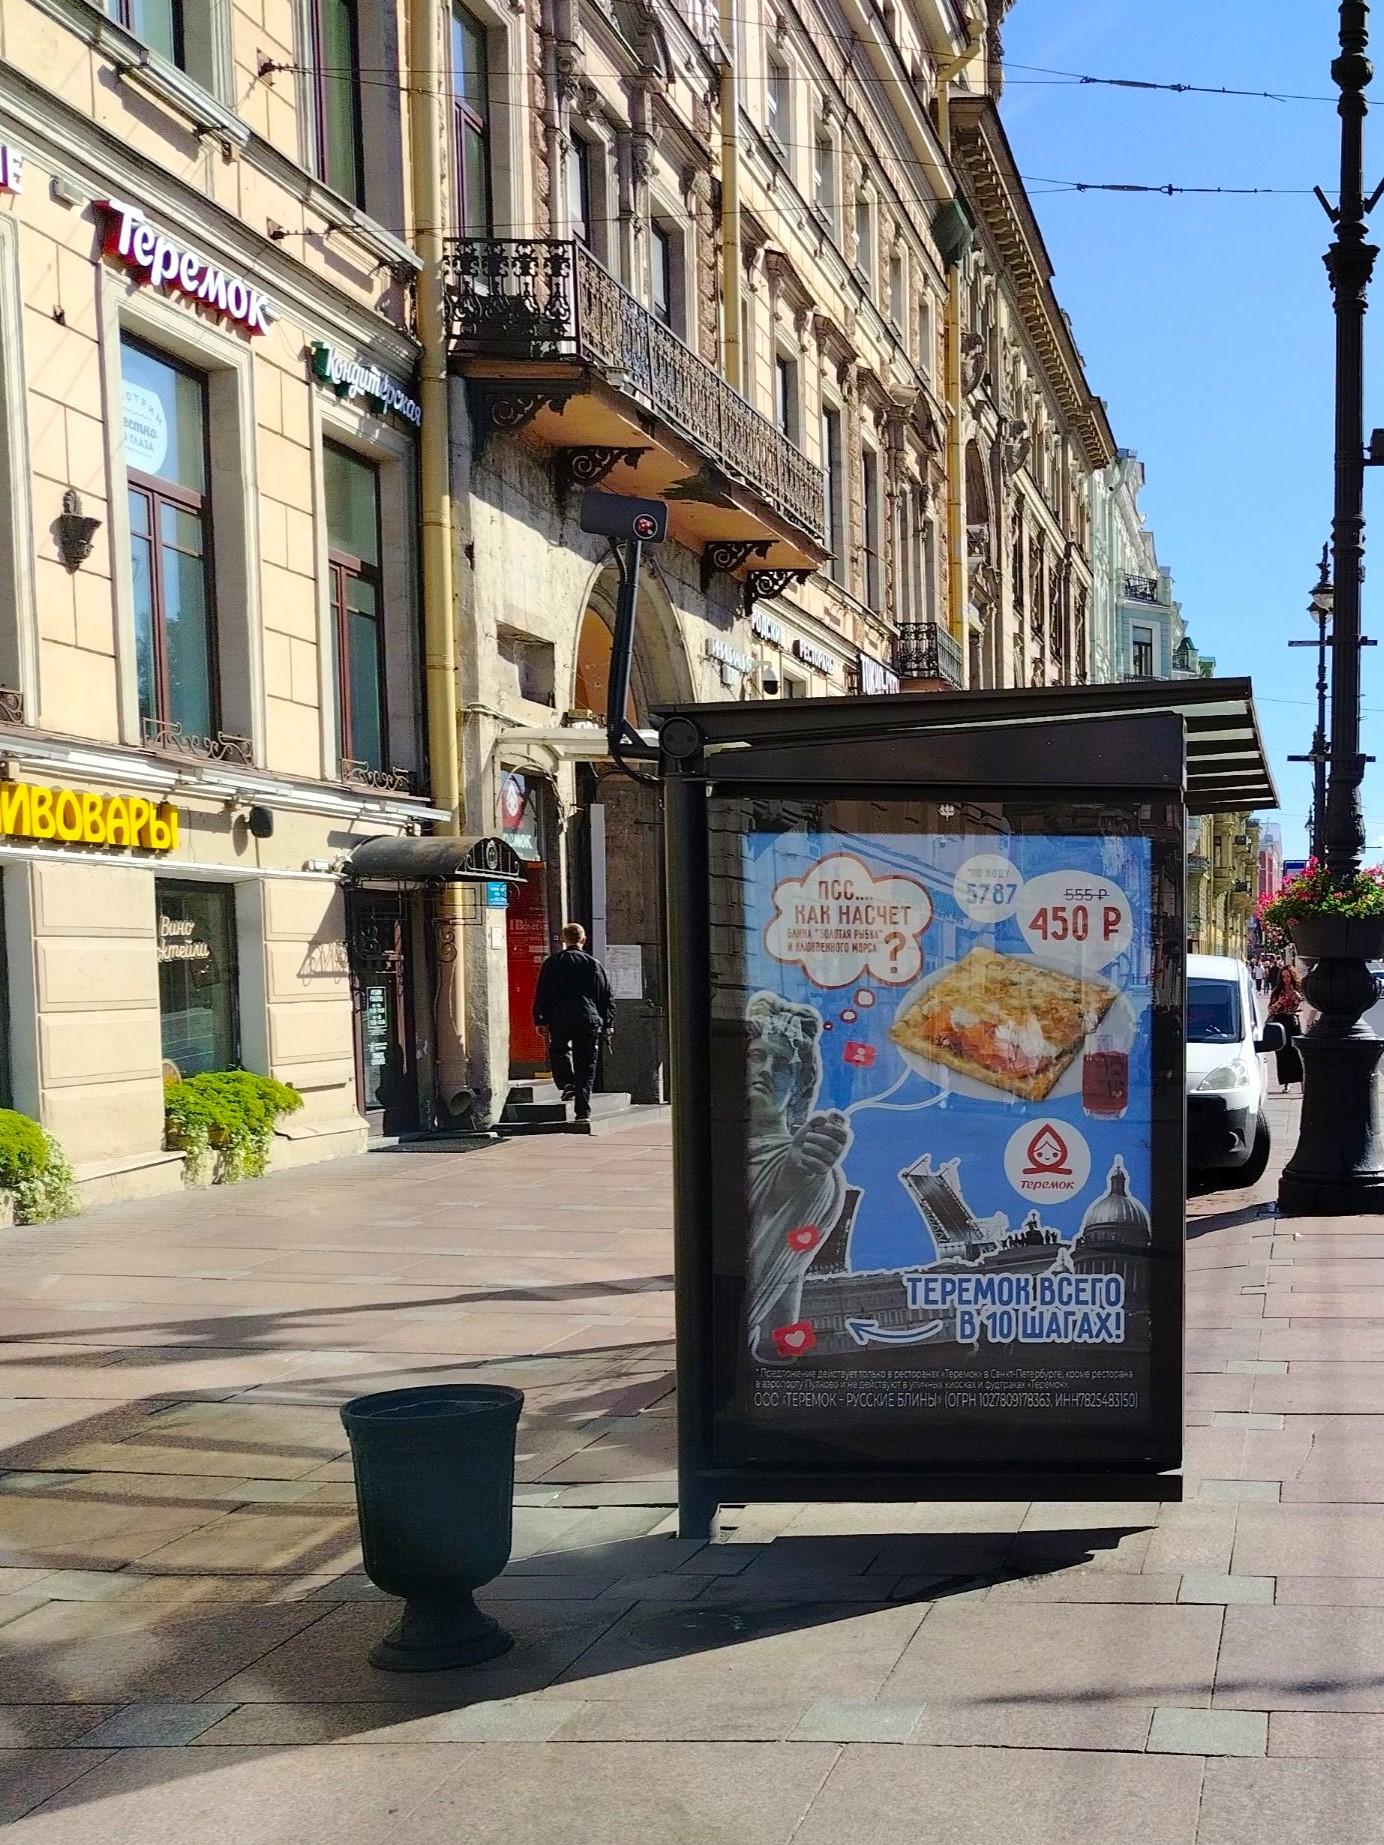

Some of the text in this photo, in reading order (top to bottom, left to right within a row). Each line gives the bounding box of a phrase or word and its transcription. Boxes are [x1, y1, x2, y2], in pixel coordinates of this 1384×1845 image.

[109, 199, 271, 337] Теремок
[323, 341, 421, 427] Кондитерская
[0, 783, 180, 850] ИВОВАРЫ
[966, 883, 1018, 905] 5787
[160, 914, 195, 937] Вино
[795, 904, 911, 925] КАК НАСЧЕТ
[1028, 905, 1089, 941] 450
[851, 942, 877, 953] МОРСА
[1020, 1180, 1075, 1191] Теремок
[906, 1276, 1122, 1306] ТЕРЕМОК ВСЕГО
[960, 1311, 1122, 1339] В 10 ШАГАХ!
[817, 1369, 858, 1380] действует
[859, 1369, 886, 1379] только
[893, 1369, 940, 1380] ресторанах
[1092, 1369, 1134, 1380] ресторана
[754, 1392, 779, 1407] ООО
[846, 1392, 895, 1408] РУССКИЕ
[944, 1391, 976, 1408] (ОГРН
